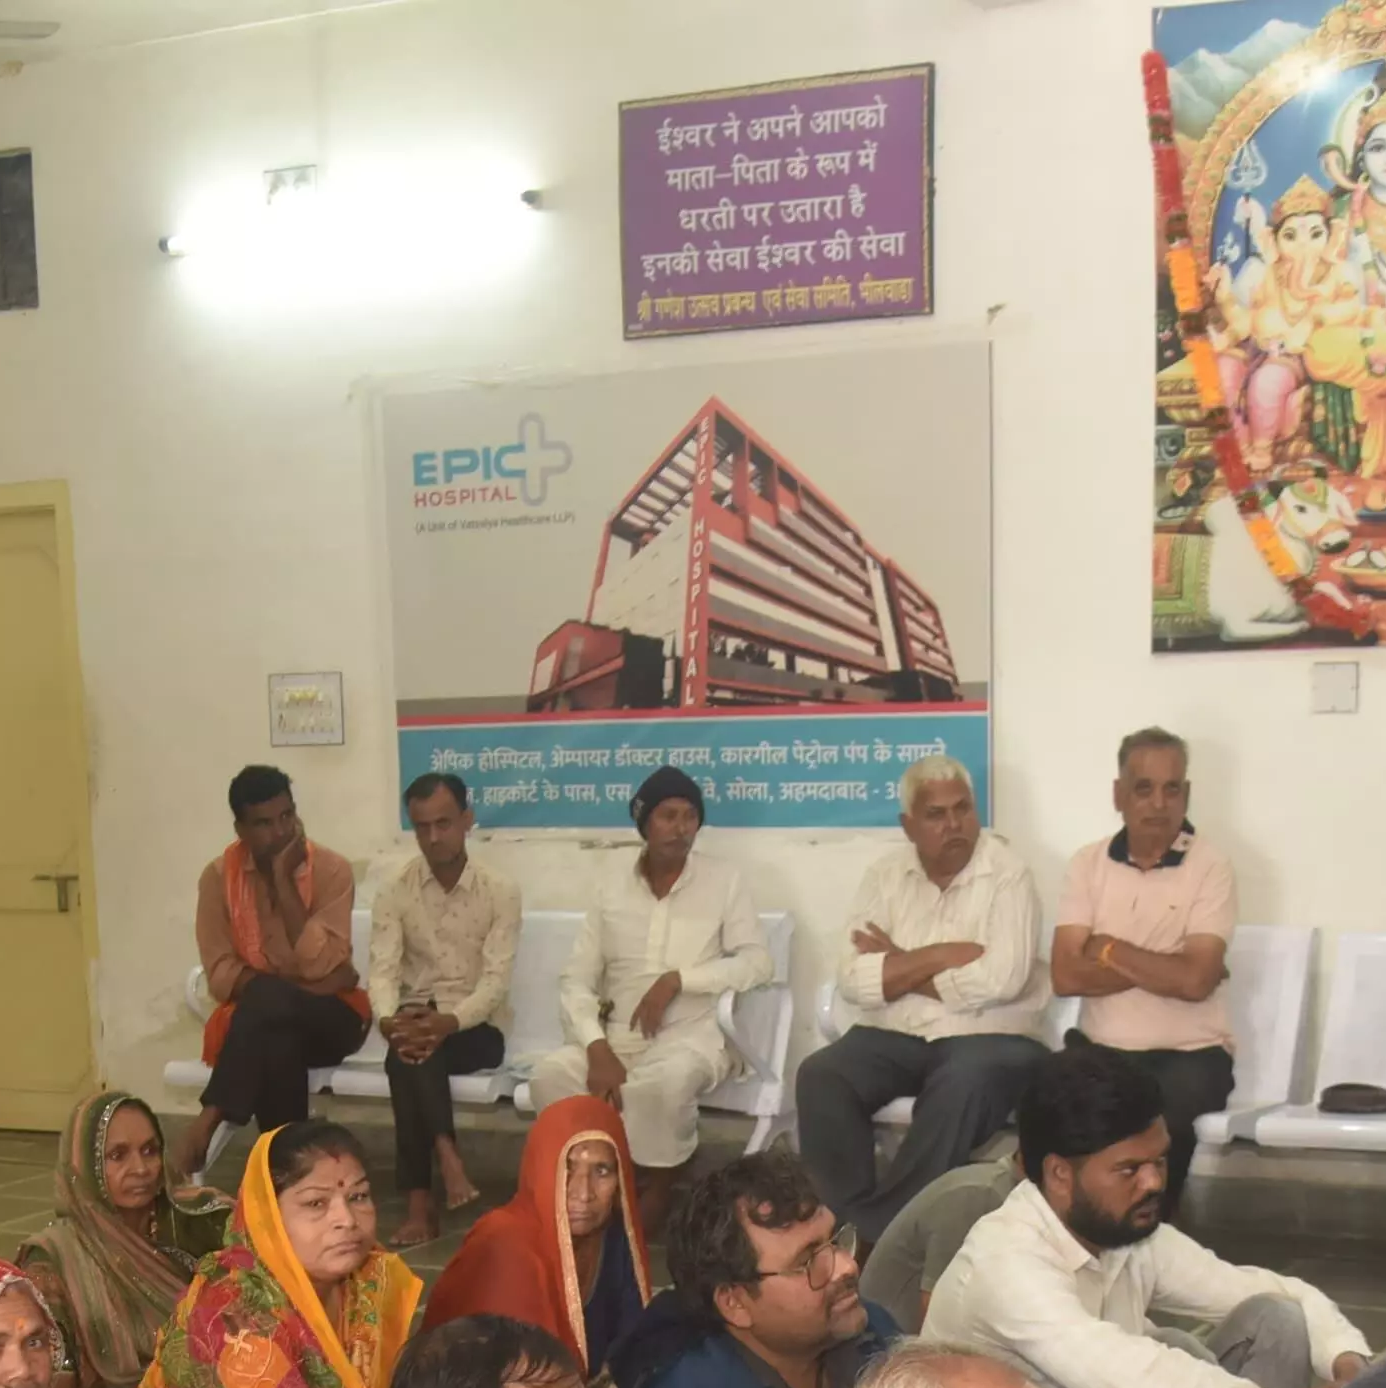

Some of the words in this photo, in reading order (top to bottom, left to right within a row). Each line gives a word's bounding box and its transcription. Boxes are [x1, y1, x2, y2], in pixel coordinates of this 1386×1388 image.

[656, 118, 717, 155] ईश्वर
[722, 112, 741, 144] ने
[747, 105, 805, 141] अपने
[810, 95, 888, 135] आपको
[786, 148, 810, 180] के
[814, 149, 852, 178] रूप
[856, 140, 879, 172] में
[679, 197, 738, 233] धरती
[741, 202, 775, 228] पर
[778, 193, 845, 225] उतारा
[848, 183, 868, 219] है
[641, 242, 700, 282] इनकी
[706, 240, 752, 273] सेवा
[755, 235, 818, 273] ईश्वर
[821, 228, 853, 262] की
[858, 225, 907, 260] सेवा
[413, 443, 527, 487] EPIC
[413, 485, 518, 508] HOSPITAL
[684, 517, 705, 706] HOSPITAL
[719, 740, 789, 766] कारगील
[792, 739, 840, 769] पेट्रोल
[844, 740, 869, 764] पंप
[873, 737, 893, 763] के
[541, 778, 560, 801] के
[564, 783, 601, 806] पास,
[779, 782, 869, 803] अहमदाबाद
